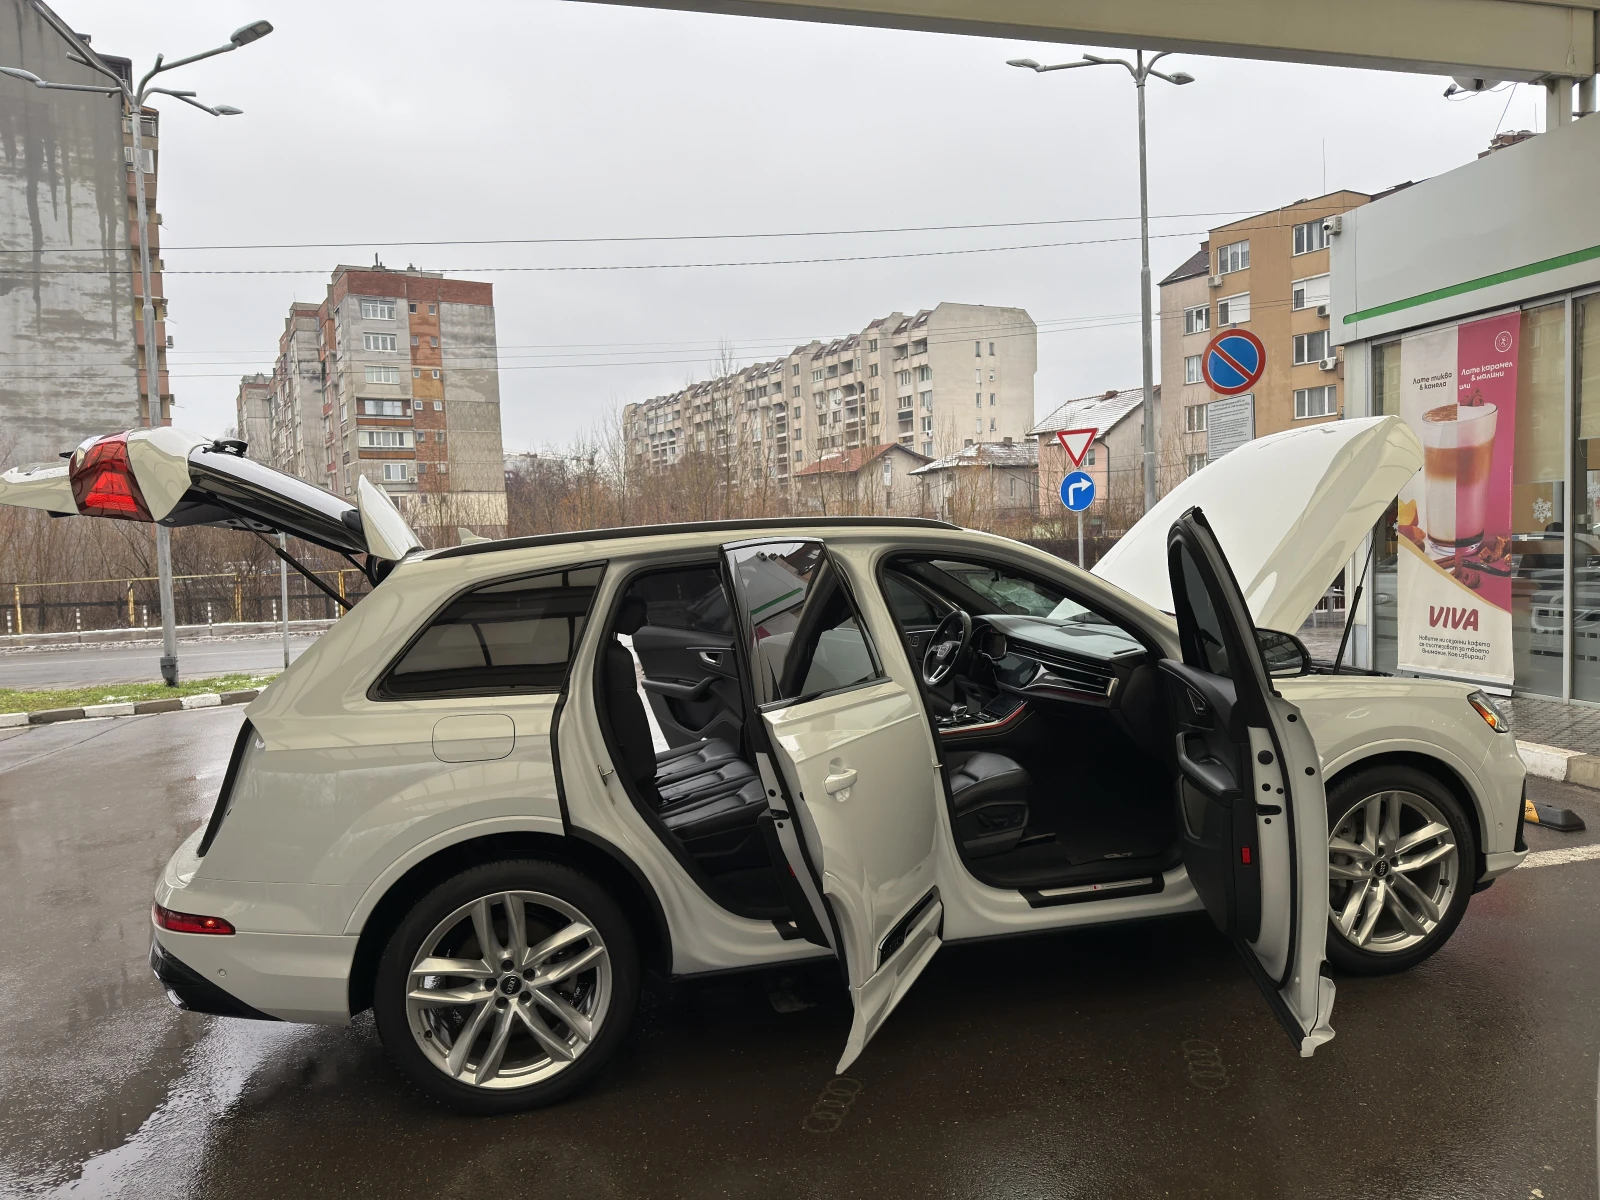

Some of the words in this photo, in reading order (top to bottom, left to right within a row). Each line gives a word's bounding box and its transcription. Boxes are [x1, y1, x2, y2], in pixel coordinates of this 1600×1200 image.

[1461, 367, 1480, 375] Лате
[1481, 361, 1513, 372] карамел
[1413, 377, 1430, 385] Лате
[1430, 372, 1453, 381] тиква
[1476, 371, 1505, 381] малини
[1424, 381, 1447, 390] канела
[1429, 605, 1479, 632] VIVA
[1418, 634, 1438, 642] Новите
[1467, 639, 1491, 648] кафета
